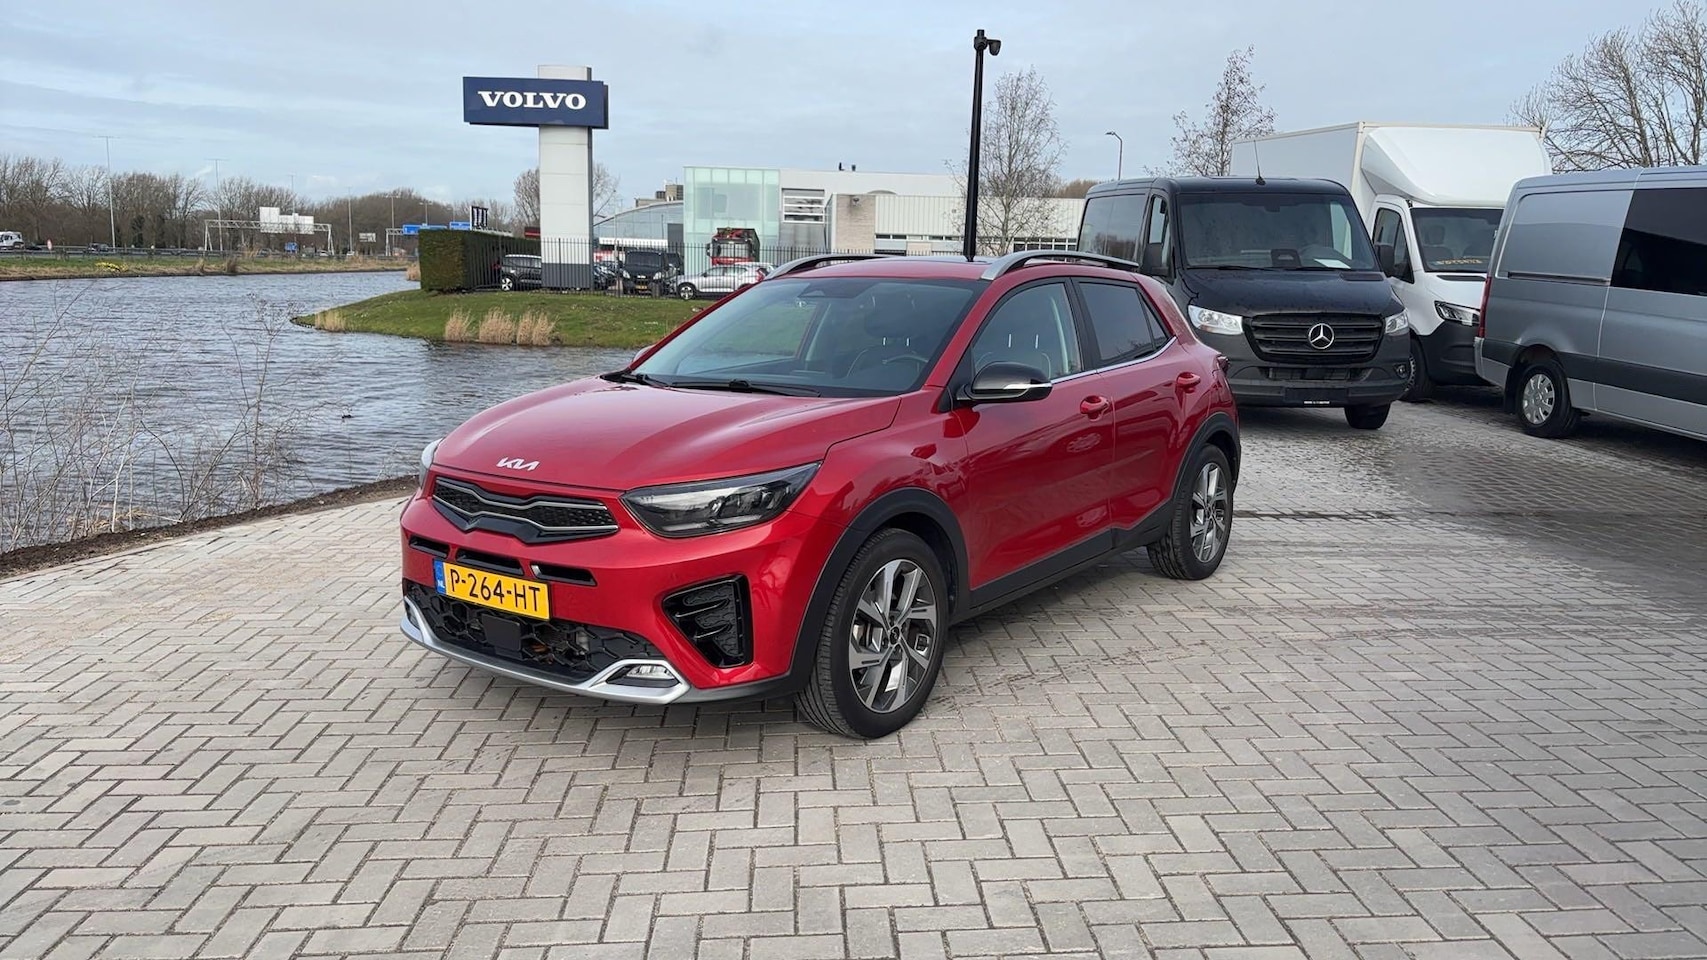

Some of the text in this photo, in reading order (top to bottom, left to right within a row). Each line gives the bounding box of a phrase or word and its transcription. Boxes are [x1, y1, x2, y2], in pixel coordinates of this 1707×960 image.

[477, 91, 587, 110] VOLVO
[496, 457, 539, 471] KIA
[450, 568, 541, 612] P-264-HT
